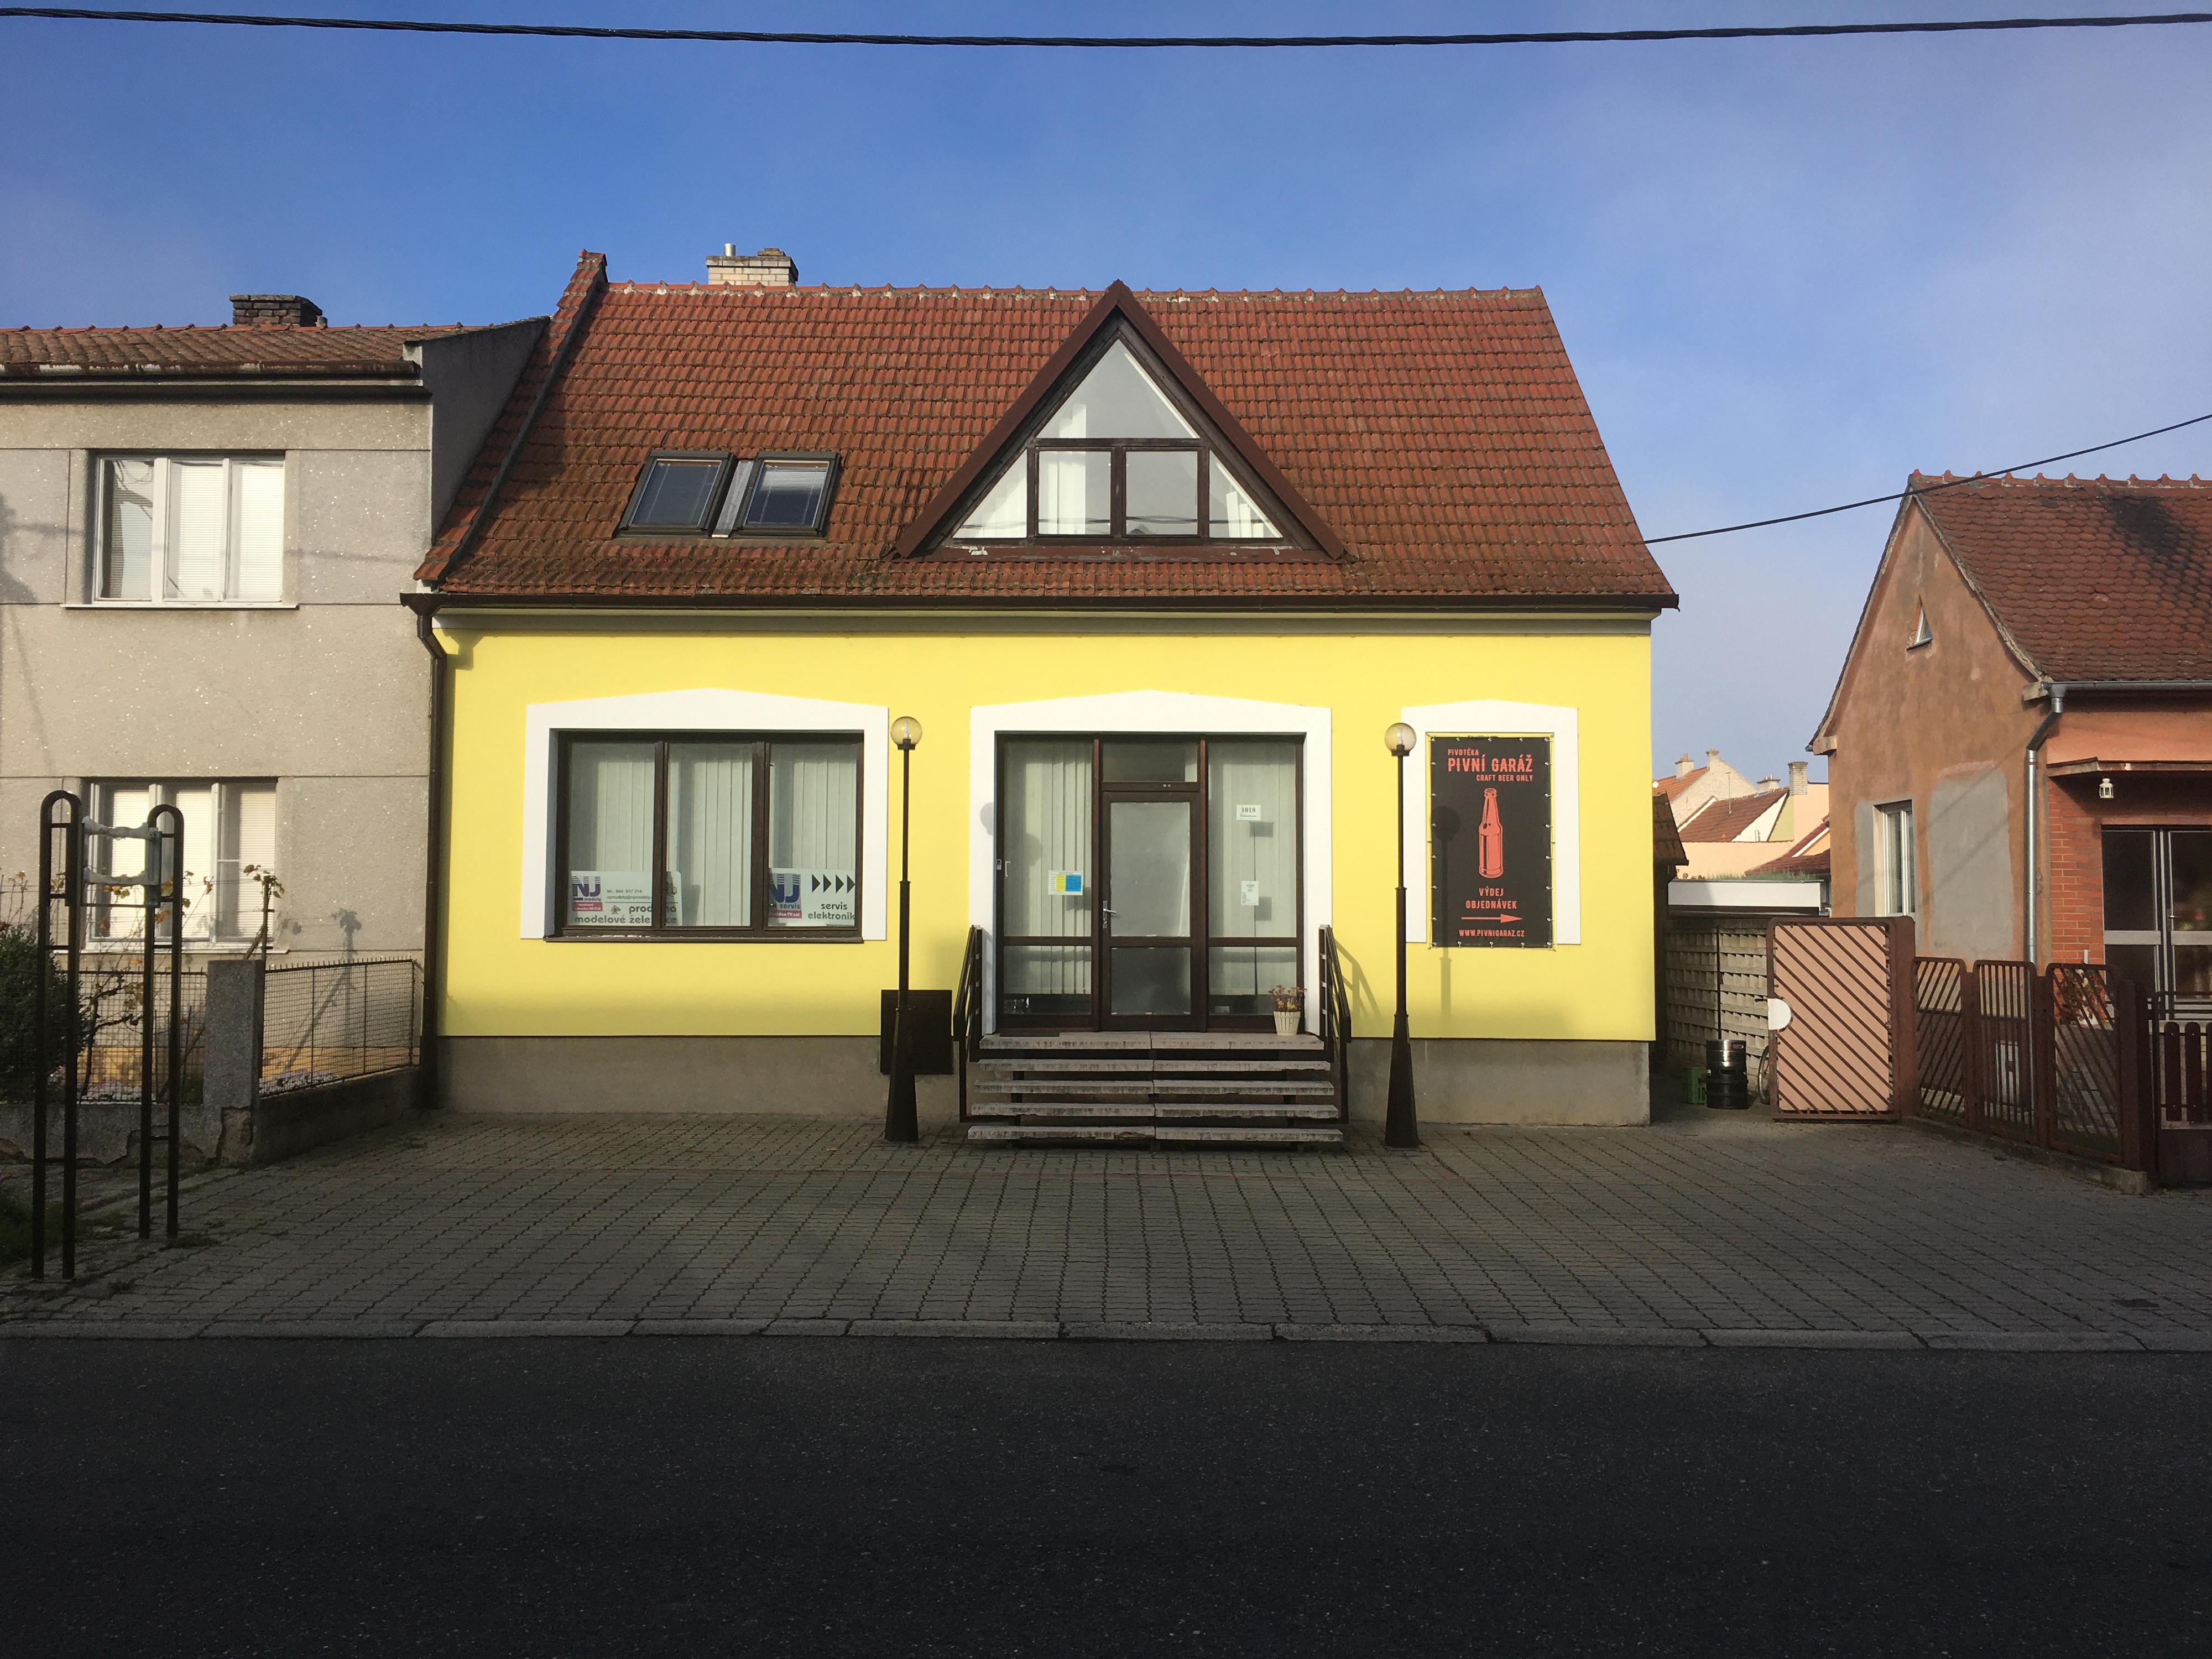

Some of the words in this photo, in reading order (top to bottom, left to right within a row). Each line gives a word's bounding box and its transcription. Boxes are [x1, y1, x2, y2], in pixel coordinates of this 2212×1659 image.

[1448, 754, 1486, 772] PIVNÍ
[1491, 754, 1533, 773] GARÁŽ
[572, 876, 601, 897] NJ
[1479, 885, 1504, 896] VÝDEJ
[821, 901, 848, 910] servis
[1465, 898, 1517, 909] OBJEDNÁVEK
[575, 915, 627, 924] modelové
[1459, 929, 1525, 937] WWW.PIVNIGARAZ.CZ
